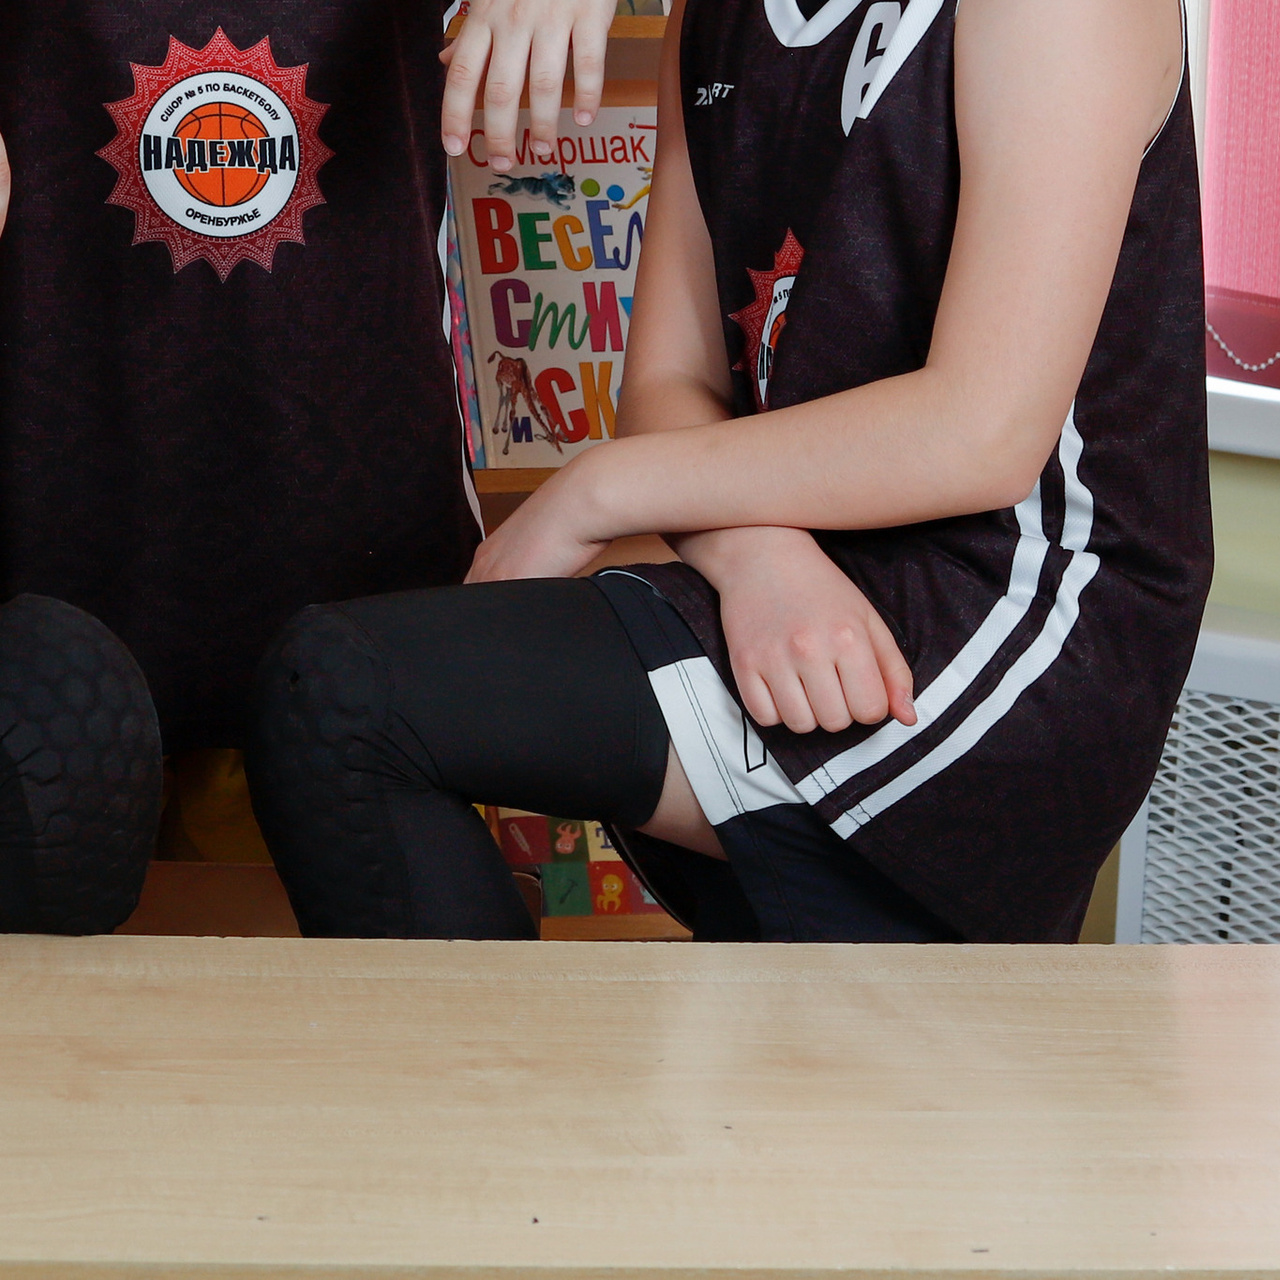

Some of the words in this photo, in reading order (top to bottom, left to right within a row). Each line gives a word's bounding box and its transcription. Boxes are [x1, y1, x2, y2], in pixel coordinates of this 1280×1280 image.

[160, 96, 184, 123] СШОР
[197, 85, 205, 95] 5
[205, 83, 221, 93] ПО
[222, 83, 281, 122] БАСКЕТБОЛУ
[143, 133, 297, 174] НАДЕЖДА
[185, 207, 262, 228] ОРЕНБУРЖЬЕ
